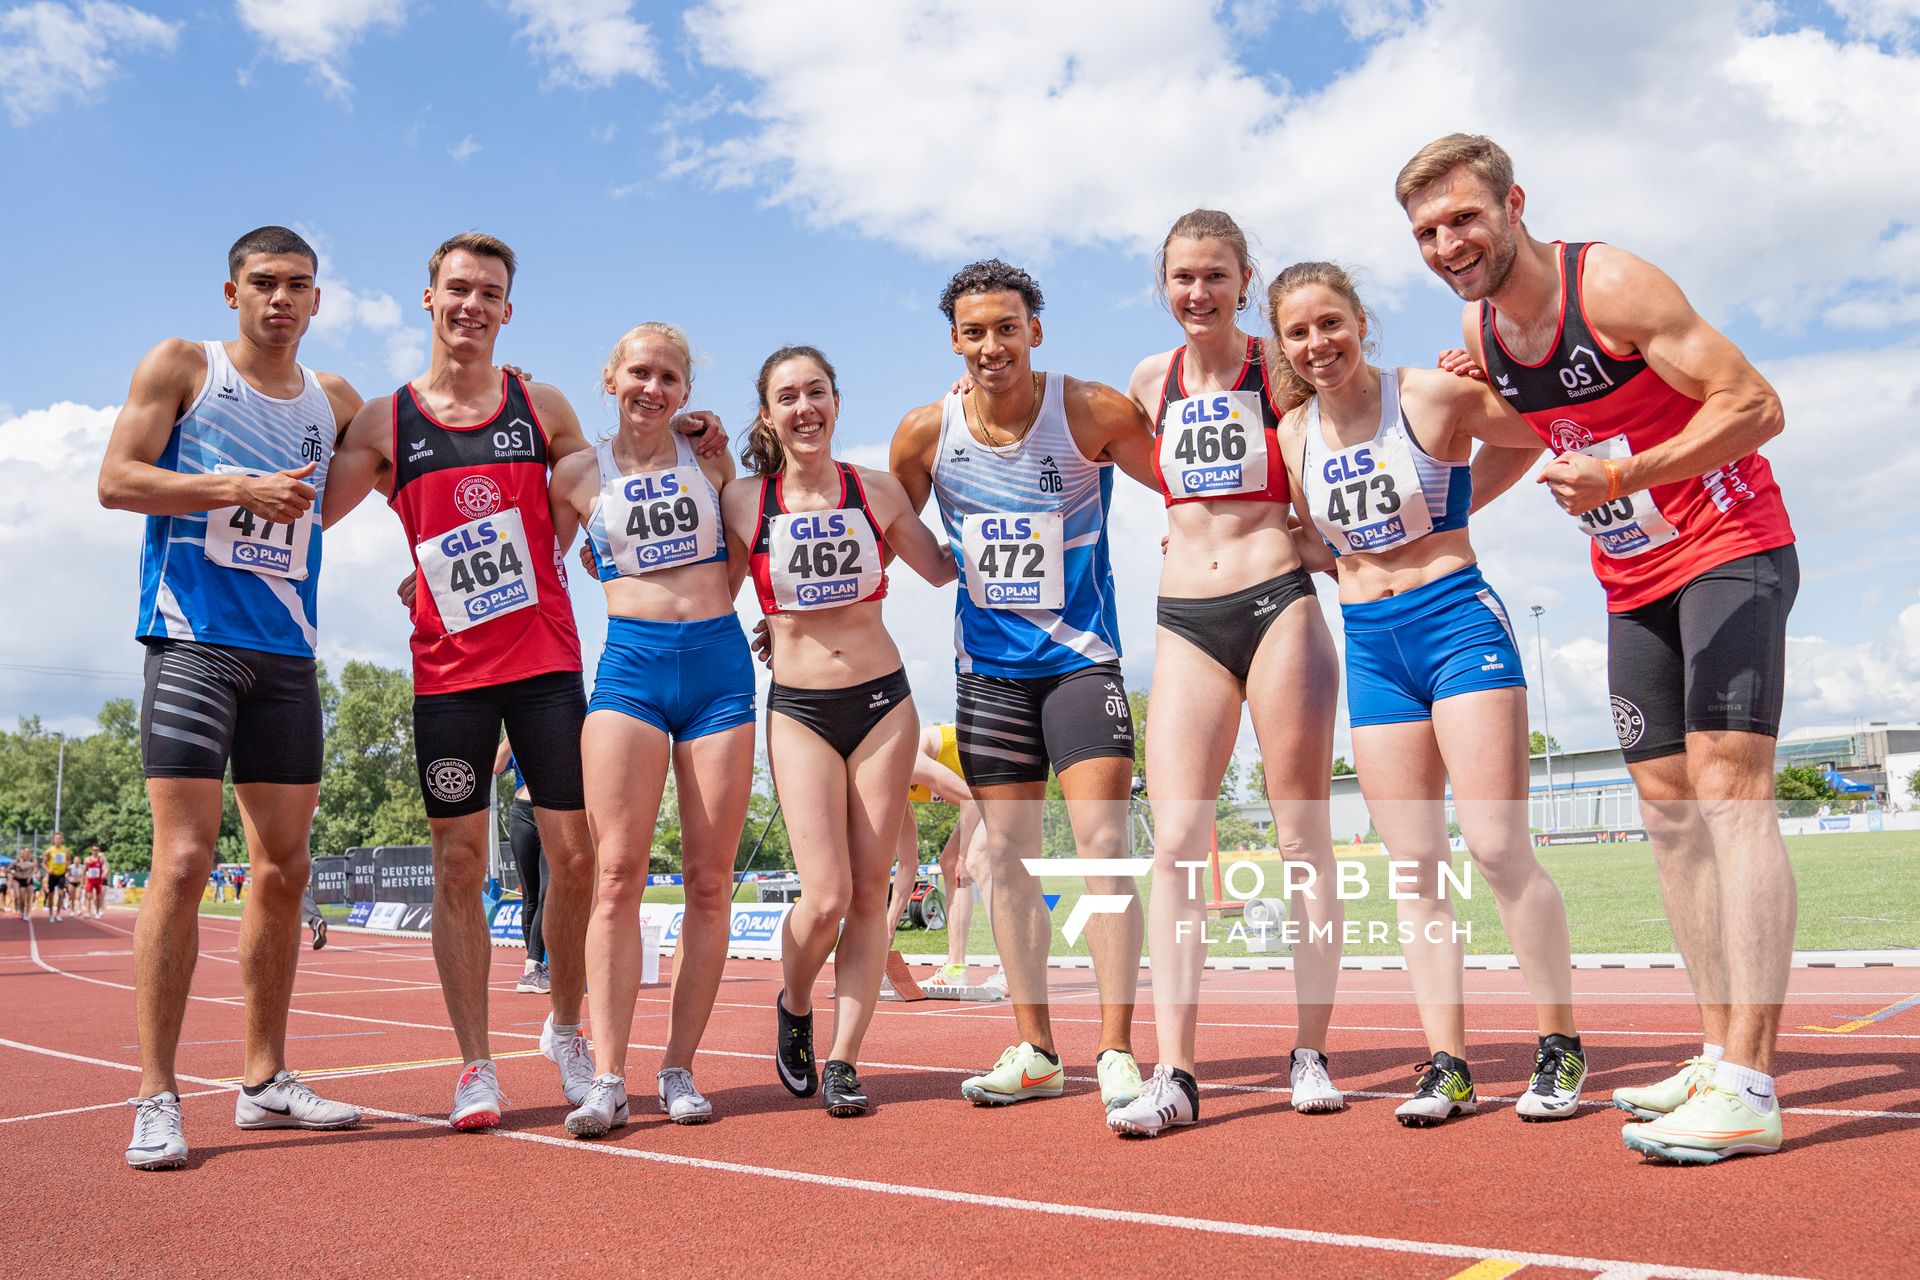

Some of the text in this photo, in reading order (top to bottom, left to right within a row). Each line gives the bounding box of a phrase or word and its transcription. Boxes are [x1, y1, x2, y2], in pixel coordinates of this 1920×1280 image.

[1559, 363, 1592, 388] OS
[218, 393, 238, 402] erima
[1567, 382, 1608, 398] BauImmo
[493, 431, 523, 449] OS
[1175, 423, 1246, 464] 466
[301, 437, 322, 462] OTB
[408, 449, 433, 462] erima
[494, 449, 531, 457] BauImmo
[1039, 470, 1063, 493] OTB
[1205, 469, 1240, 482] PLAN
[491, 492, 500, 500] G
[1327, 474, 1401, 526] 473
[626, 496, 699, 540] 469
[1364, 521, 1400, 541] PLAN
[1609, 527, 1642, 545] PLAN
[662, 540, 696, 555] PLAN
[260, 548, 289, 564] PLAN
[788, 540, 862, 579] 462
[978, 543, 1045, 578] 472
[450, 542, 523, 594] 464
[490, 585, 525, 604] PLAN
[822, 583, 855, 595] PLAN
[1006, 587, 1037, 596] PLAN
[1253, 603, 1277, 617] erima
[1481, 662, 1504, 671] erima
[869, 698, 889, 708] erima
[1105, 696, 1128, 718] OTB
[1707, 703, 1742, 712] erima
[1631, 715, 1641, 725] G
[430, 761, 468, 775] Leichtathletik
[466, 773, 474, 782] G
[750, 914, 780, 931] PLAN
